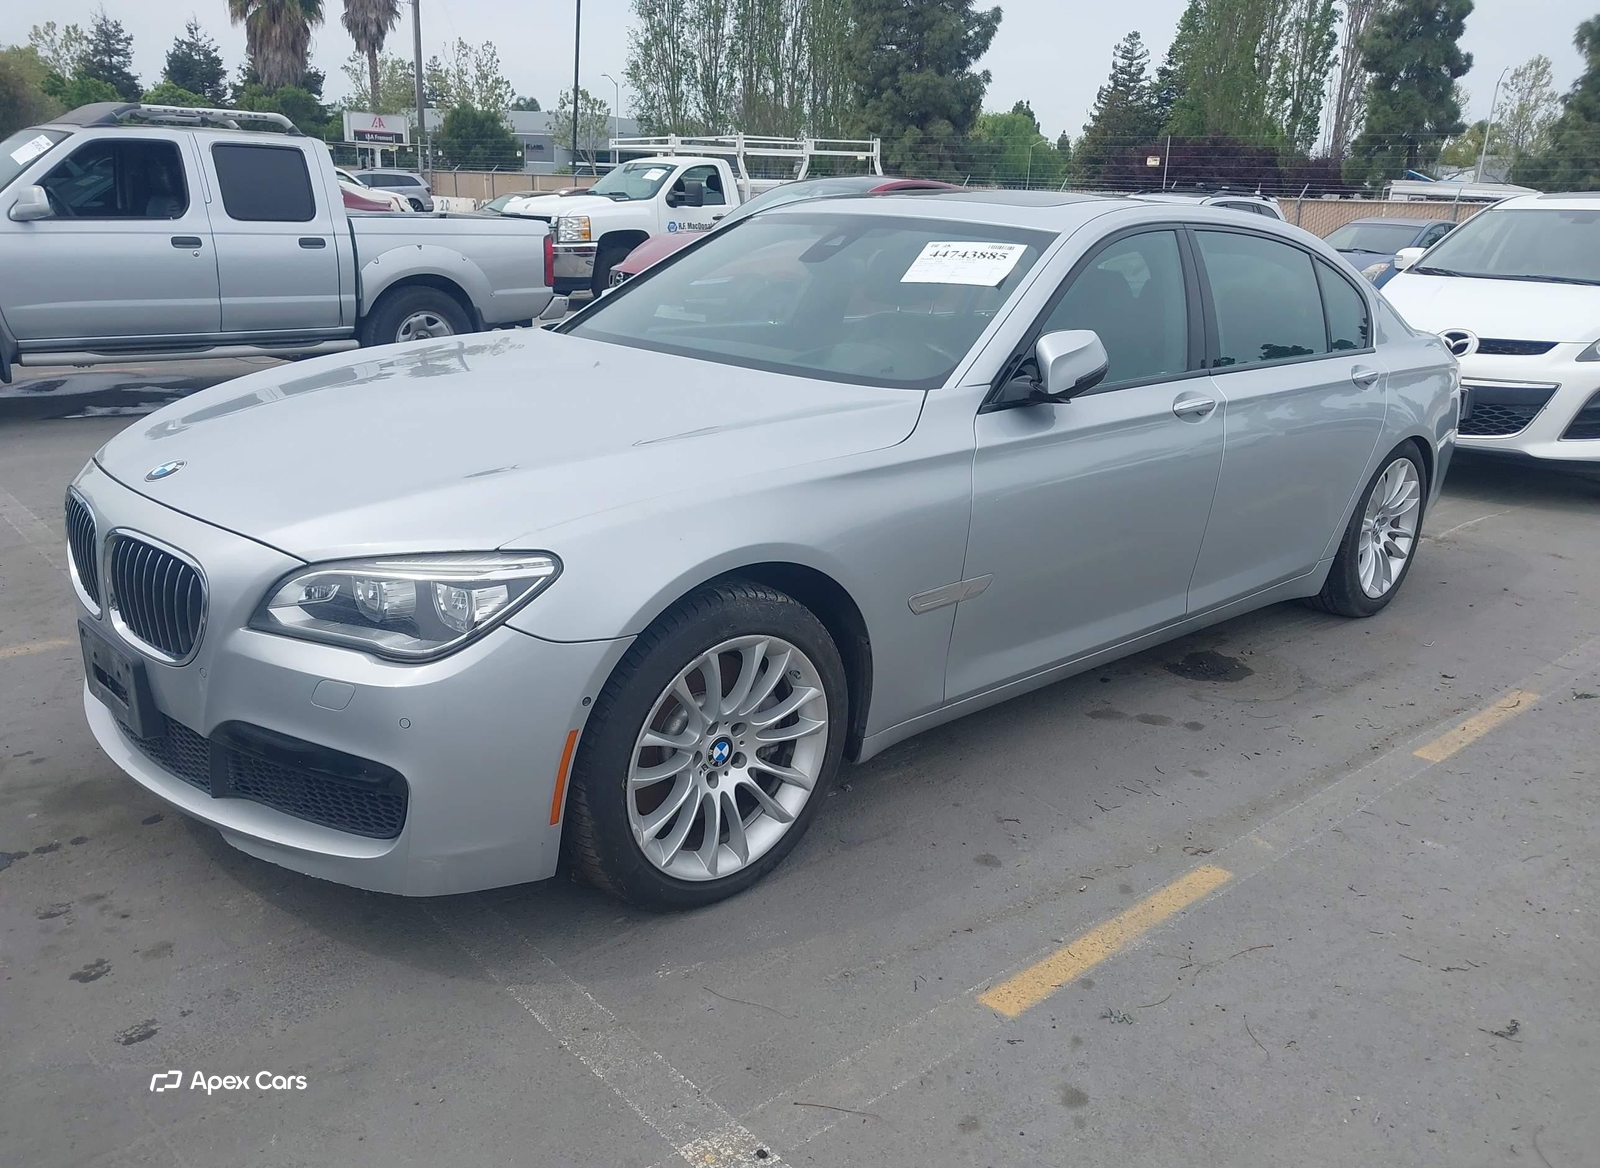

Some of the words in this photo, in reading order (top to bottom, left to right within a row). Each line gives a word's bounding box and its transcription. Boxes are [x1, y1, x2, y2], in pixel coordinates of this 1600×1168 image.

[147, 107, 215, 116] CREW
[222, 112, 268, 120] CAB
[929, 251, 1008, 260] 44743885
